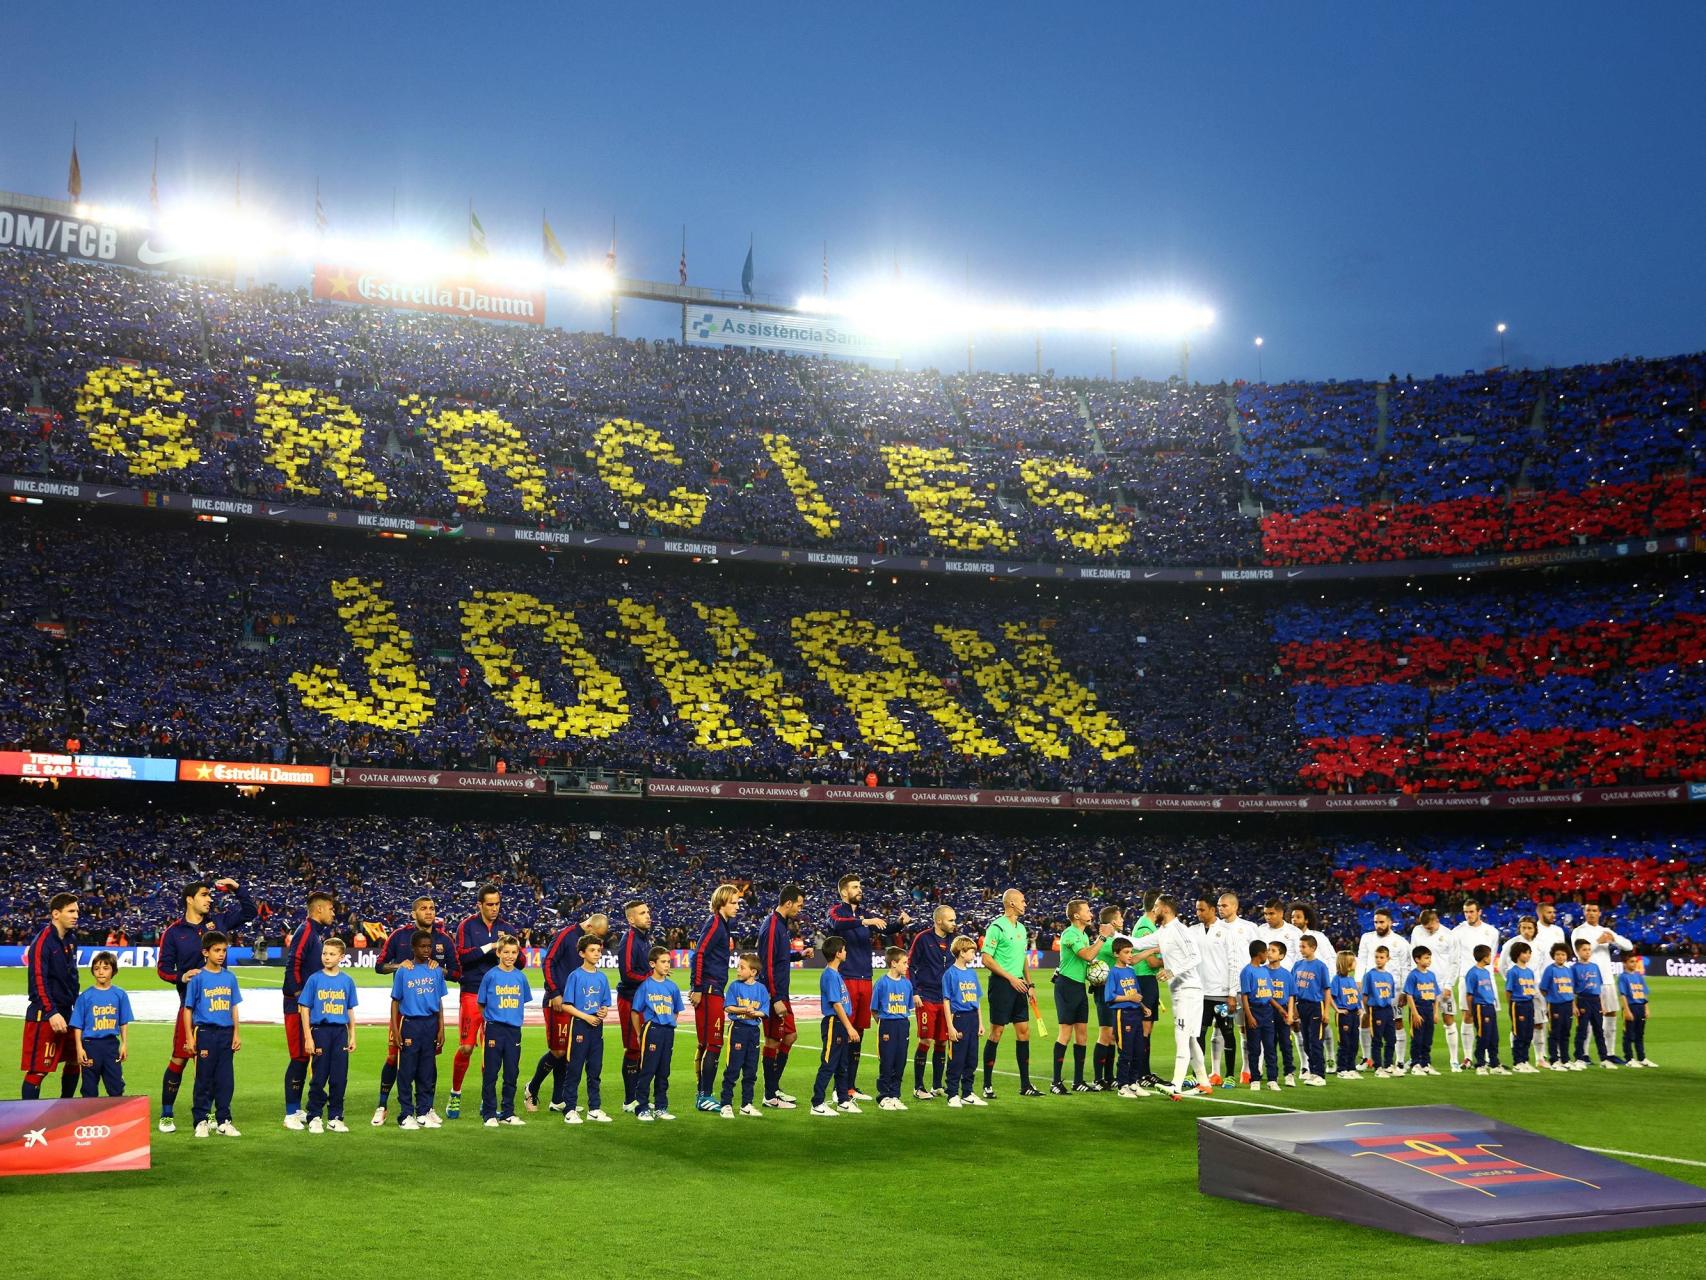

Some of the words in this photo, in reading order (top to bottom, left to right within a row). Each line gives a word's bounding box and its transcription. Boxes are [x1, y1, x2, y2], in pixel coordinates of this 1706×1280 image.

[357, 275, 453, 307] Estrella
[457, 287, 535, 317] Damm
[722, 318, 823, 342] Assistència
[14, 480, 79, 496] NIKE.COM/FCB
[192, 498, 253, 514] NIKE.COM/FCB
[358, 515, 415, 529] NIKE.COM/FCB
[515, 530, 569, 543] NIKE.COM/FCB
[665, 542, 717, 554] NIKE.COM/FCB
[808, 553, 858, 565] NIKE.COM/FCB
[1500, 548, 1600, 567] FCBARCELONA.CAT
[946, 562, 994, 573] NIKE.COM/FCB
[1081, 568, 1131, 578] NIKE.COM/FCB
[1221, 570, 1273, 579] NIKE.COM/FCB
[22, 764, 40, 775] EL
[214, 764, 268, 781] Estrella
[270, 767, 314, 783] Damm
[359, 773, 388, 783] QATAR
[390, 775, 427, 783] AIRWAYS
[459, 777, 488, 786] QATAR
[489, 778, 524, 787] AIRWAYS
[648, 783, 675, 792] QATAR
[677, 785, 710, 793] AIRWAYS
[738, 787, 765, 796] QATAR
[766, 788, 798, 796] AIRWAYS
[826, 790, 851, 798] QATAR
[853, 791, 884, 799] AIRWAYS
[912, 793, 936, 801] QATAR
[938, 793, 968, 801] AIRWAYS
[995, 795, 1019, 803] QATAR
[1020, 796, 1050, 804] AIRWAYS
[1508, 796, 1534, 805] QATAR
[1535, 794, 1570, 804] AIRWAYS
[1601, 792, 1627, 801] QATAR
[1630, 789, 1666, 799] AIRWAYS
[1156, 799, 1179, 808] QATAR
[1181, 799, 1211, 808] AIRWAYS
[1238, 800, 1264, 808] QATAR
[1265, 800, 1297, 808] AIRWAYS
[1326, 799, 1352, 808] QATAR
[1353, 798, 1389, 807] AIRWAYS
[1417, 798, 1444, 807] QATAR
[1445, 797, 1479, 806] AIRWAYS
[354, 950, 378, 968] Joh
[674, 953, 690, 968] 14
[1666, 958, 1706, 976] Gràcies
[322, 1001, 343, 1014] Johan
[715, 1018, 720, 1030] 4
[922, 1012, 927, 1024] 8
[558, 1023, 568, 1037] 14
[44, 1042, 56, 1057] 10
